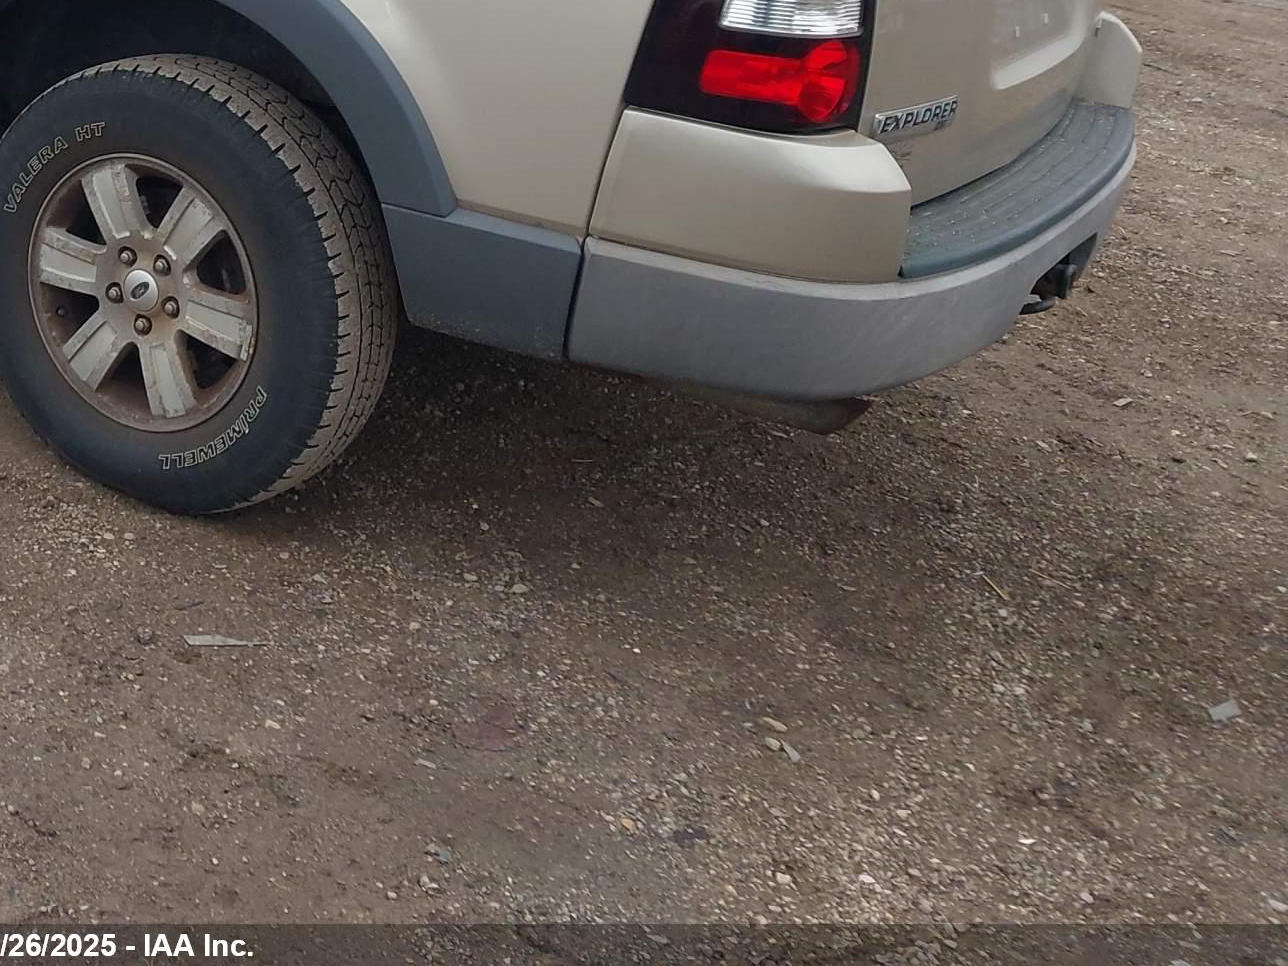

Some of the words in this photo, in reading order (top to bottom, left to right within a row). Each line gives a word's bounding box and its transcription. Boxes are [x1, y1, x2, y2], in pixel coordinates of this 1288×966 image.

[878, 100, 958, 134] EXPLORER
[3, 136, 69, 213] VALERA
[74, 121, 106, 142] HT
[158, 385, 268, 470] PRIMEWELL
